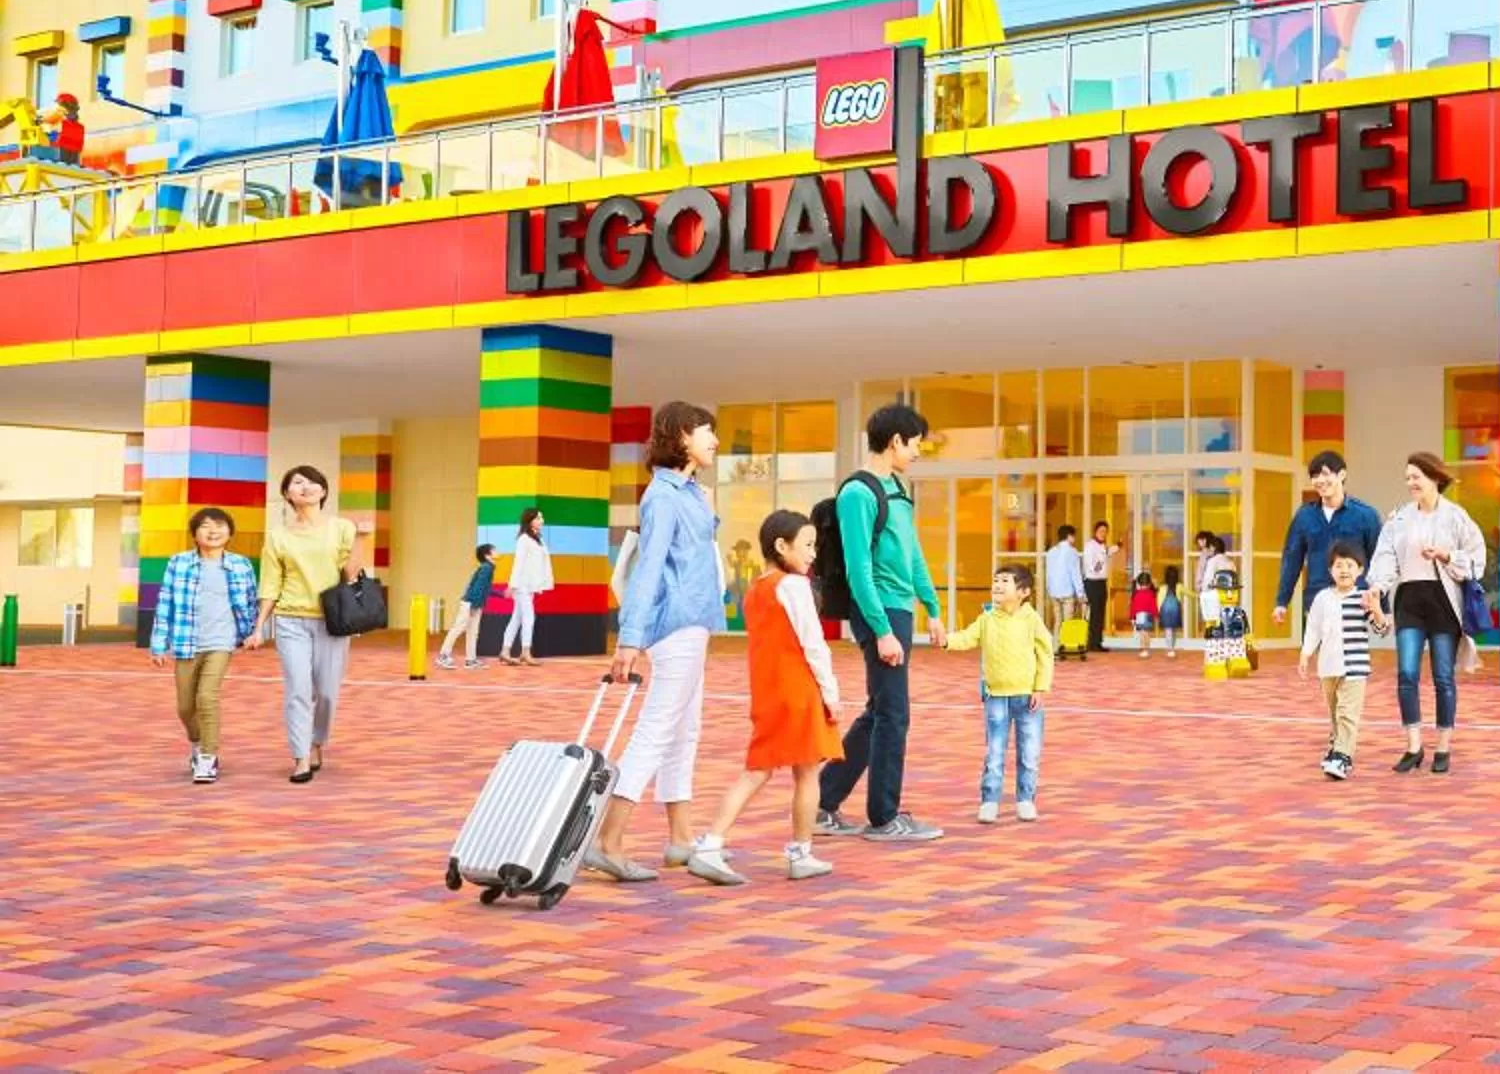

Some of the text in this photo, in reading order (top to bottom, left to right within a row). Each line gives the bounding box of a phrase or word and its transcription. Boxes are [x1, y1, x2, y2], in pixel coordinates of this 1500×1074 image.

[822, 81, 887, 126] LEGO
[505, 98, 1467, 294] LEGOLAND HOTEL
